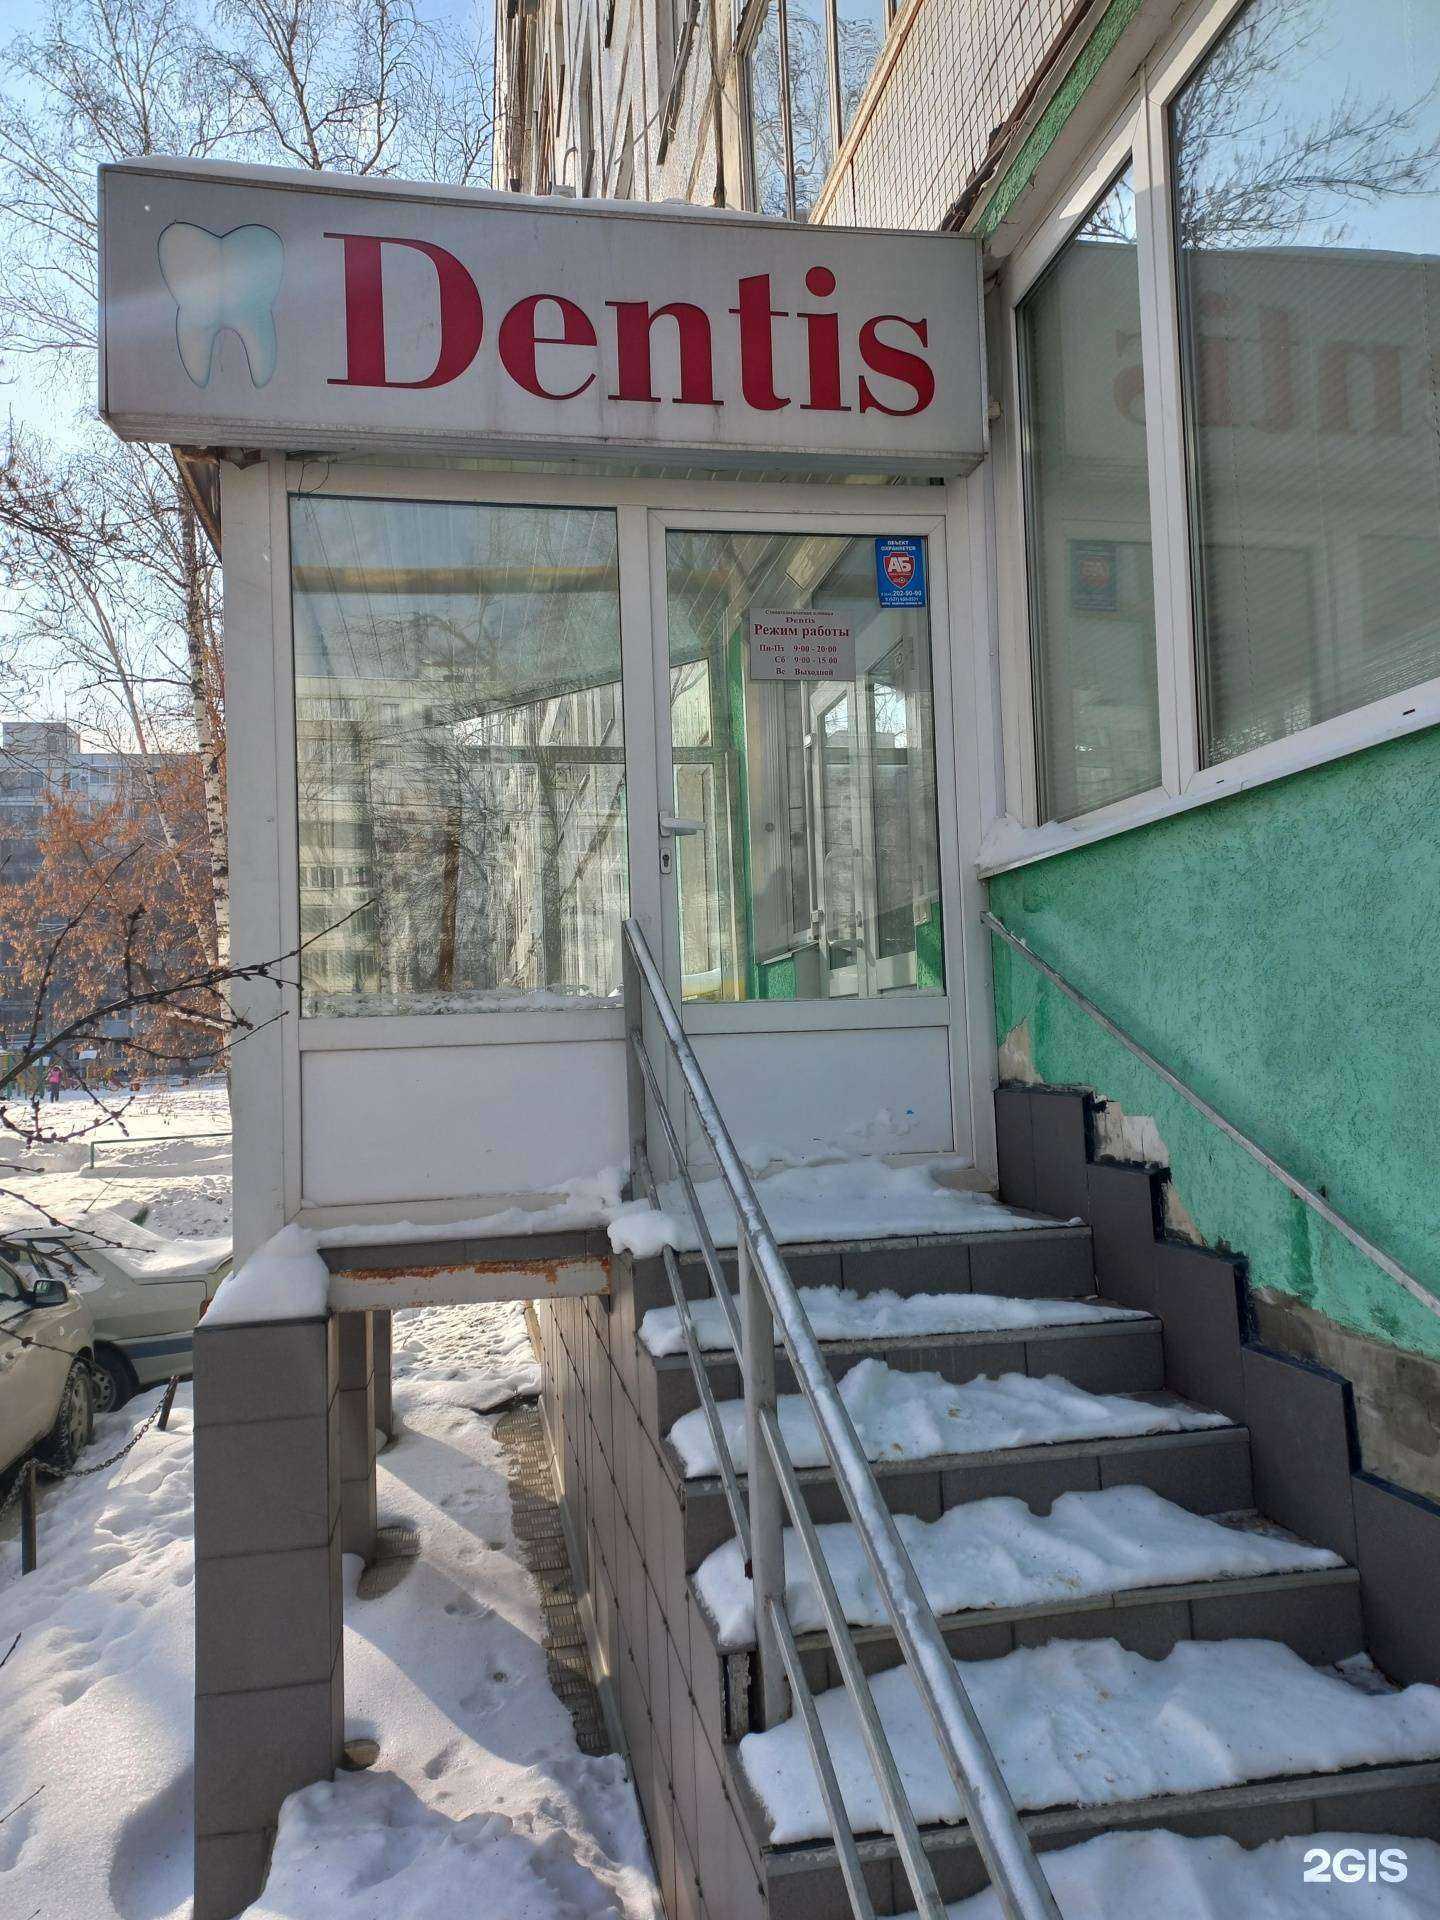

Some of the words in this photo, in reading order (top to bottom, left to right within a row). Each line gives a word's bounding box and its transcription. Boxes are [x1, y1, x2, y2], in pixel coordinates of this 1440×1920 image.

[323, 231, 936, 417] Dentis
[754, 624, 798, 636] Режим
[802, 626, 849, 638] работы
[793, 645, 810, 653] 9:00
